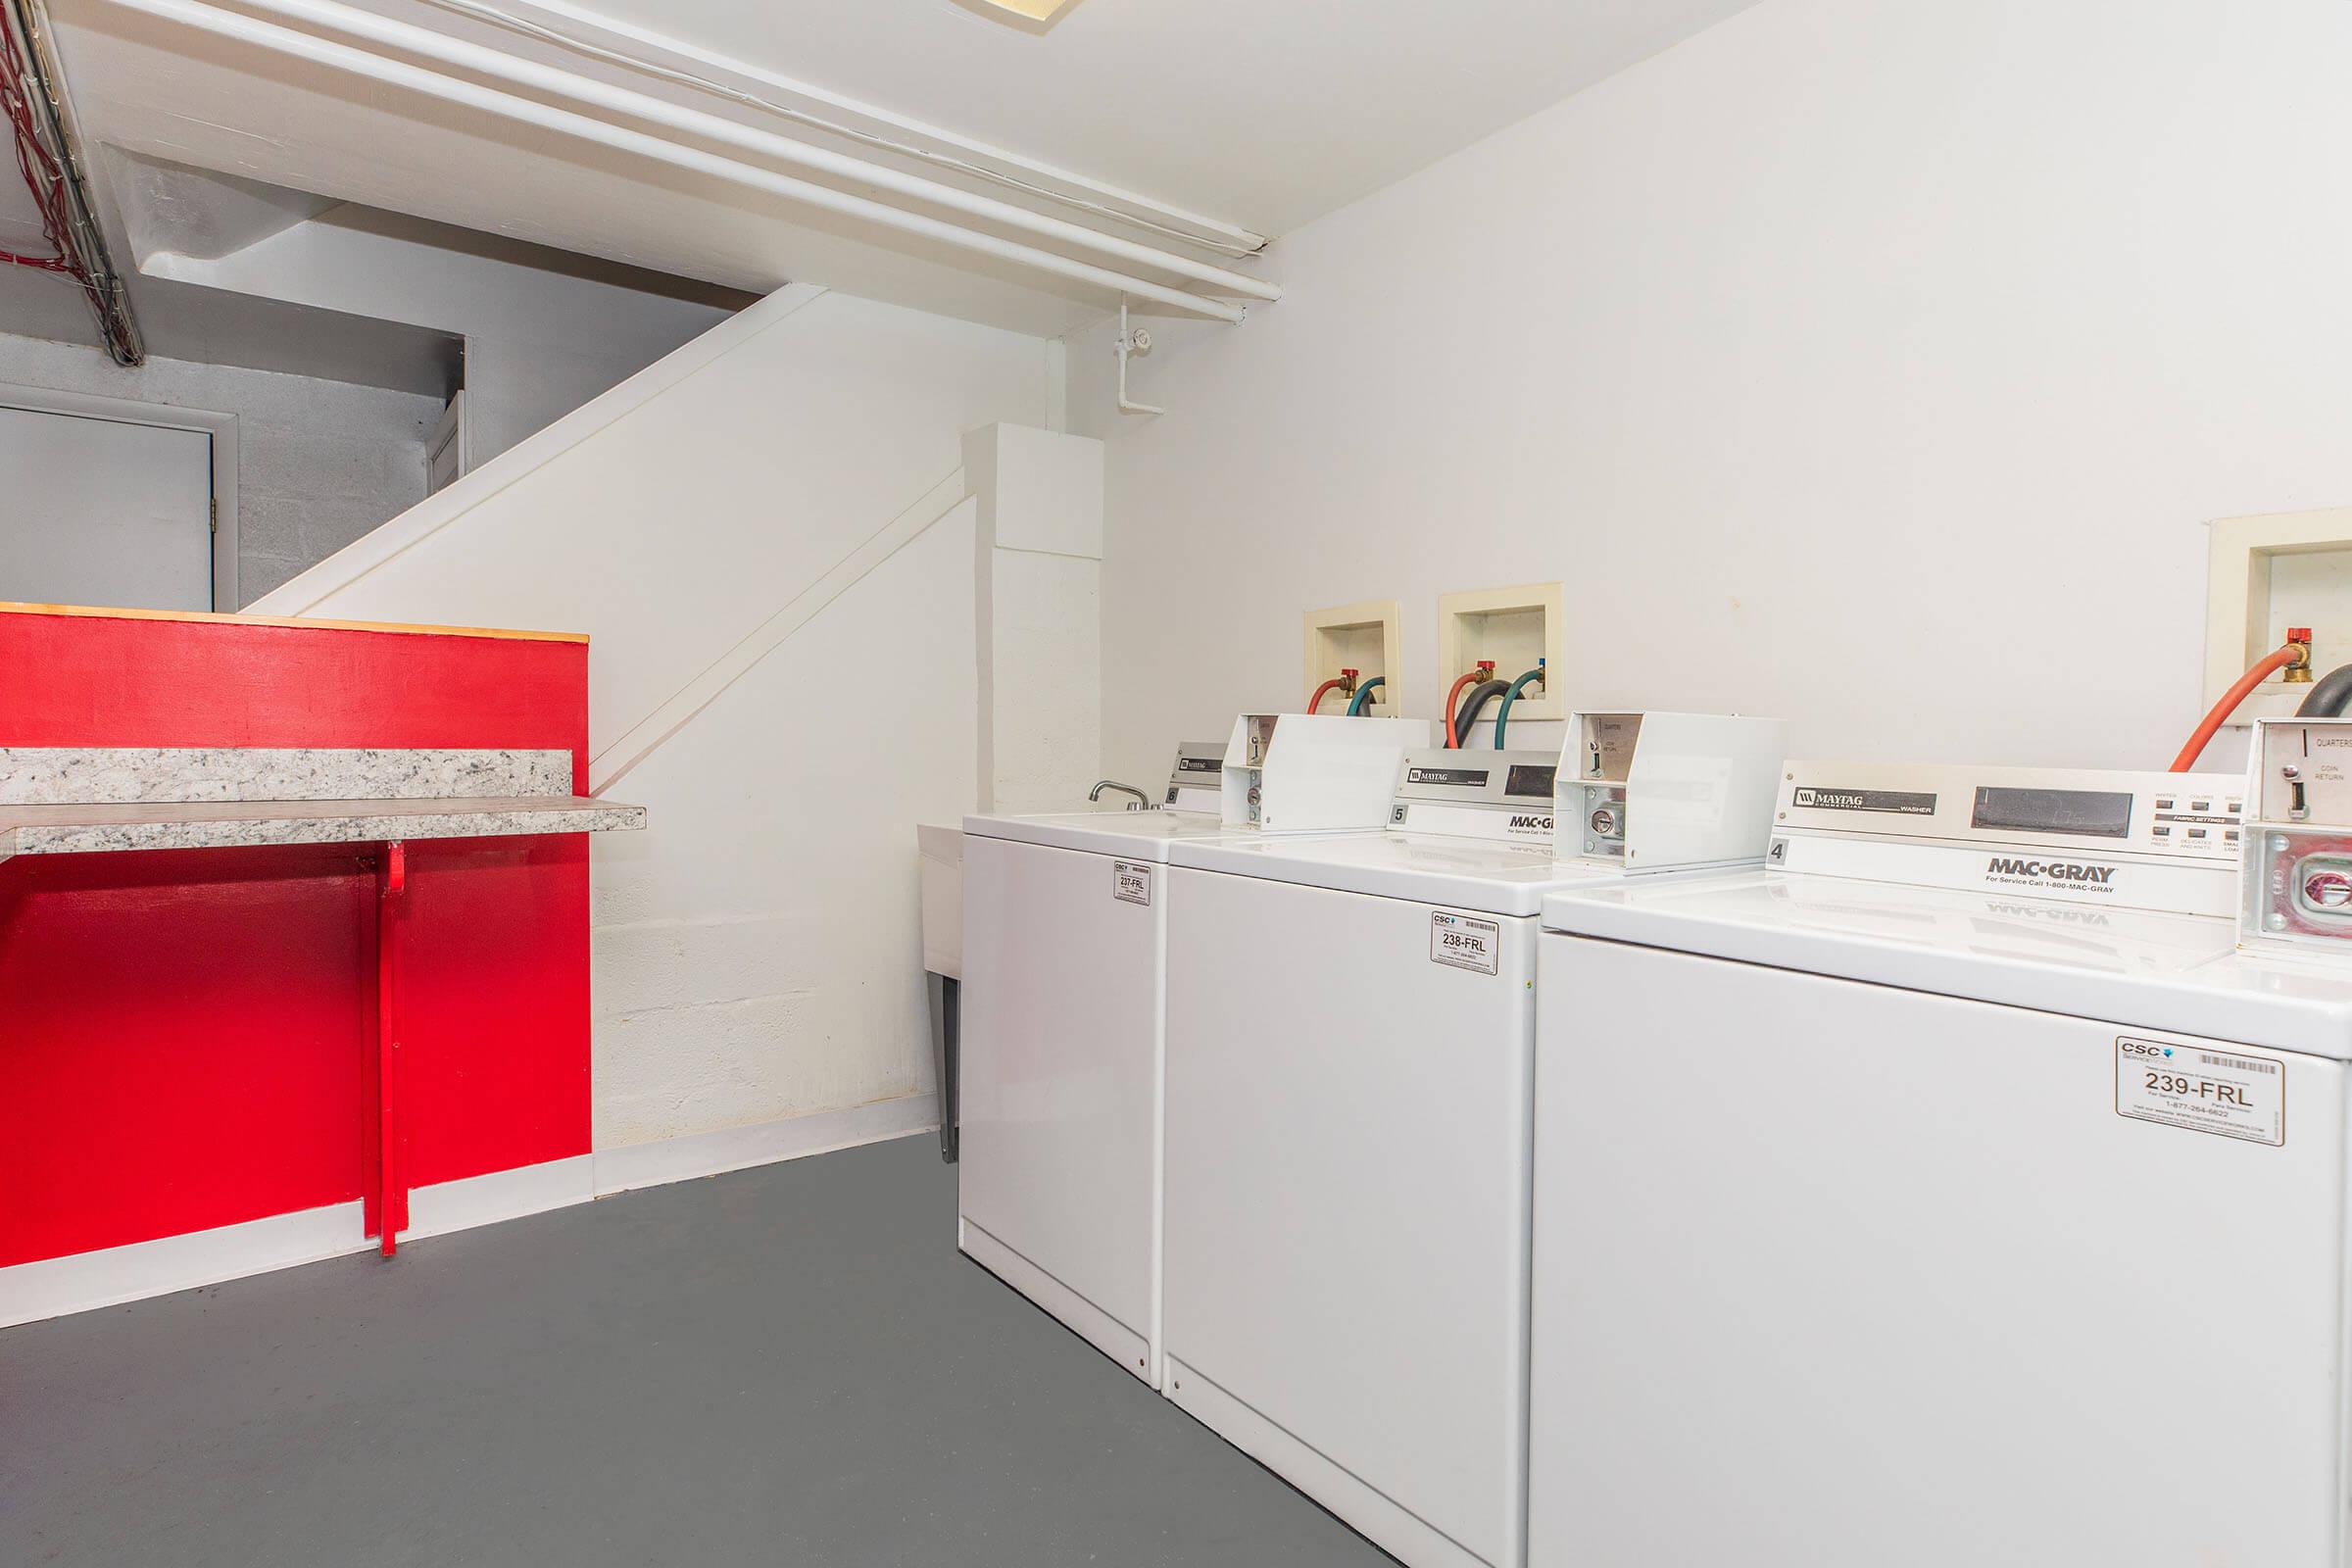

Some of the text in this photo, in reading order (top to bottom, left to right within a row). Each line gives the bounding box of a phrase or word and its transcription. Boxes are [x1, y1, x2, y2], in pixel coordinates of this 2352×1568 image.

[1421, 772, 1448, 781] MAYTAG
[1168, 791, 1176, 801] 6
[1815, 794, 1863, 806] MAYTAG
[1395, 808, 1403, 821] 5
[1771, 843, 1783, 859] 4
[1120, 876, 1145, 890] 237-FRL
[1999, 876, 2028, 886] Service
[2045, 881, 2115, 894] 1-800-MAC-GRAY
[1434, 914, 1450, 924] CSC
[1443, 933, 1487, 953] 238-FRL
[2121, 1043, 2161, 1056] CSC
[2144, 1072, 2254, 1107] 239-FRL
[2166, 1101, 2230, 1118] 1-877-264-6622
